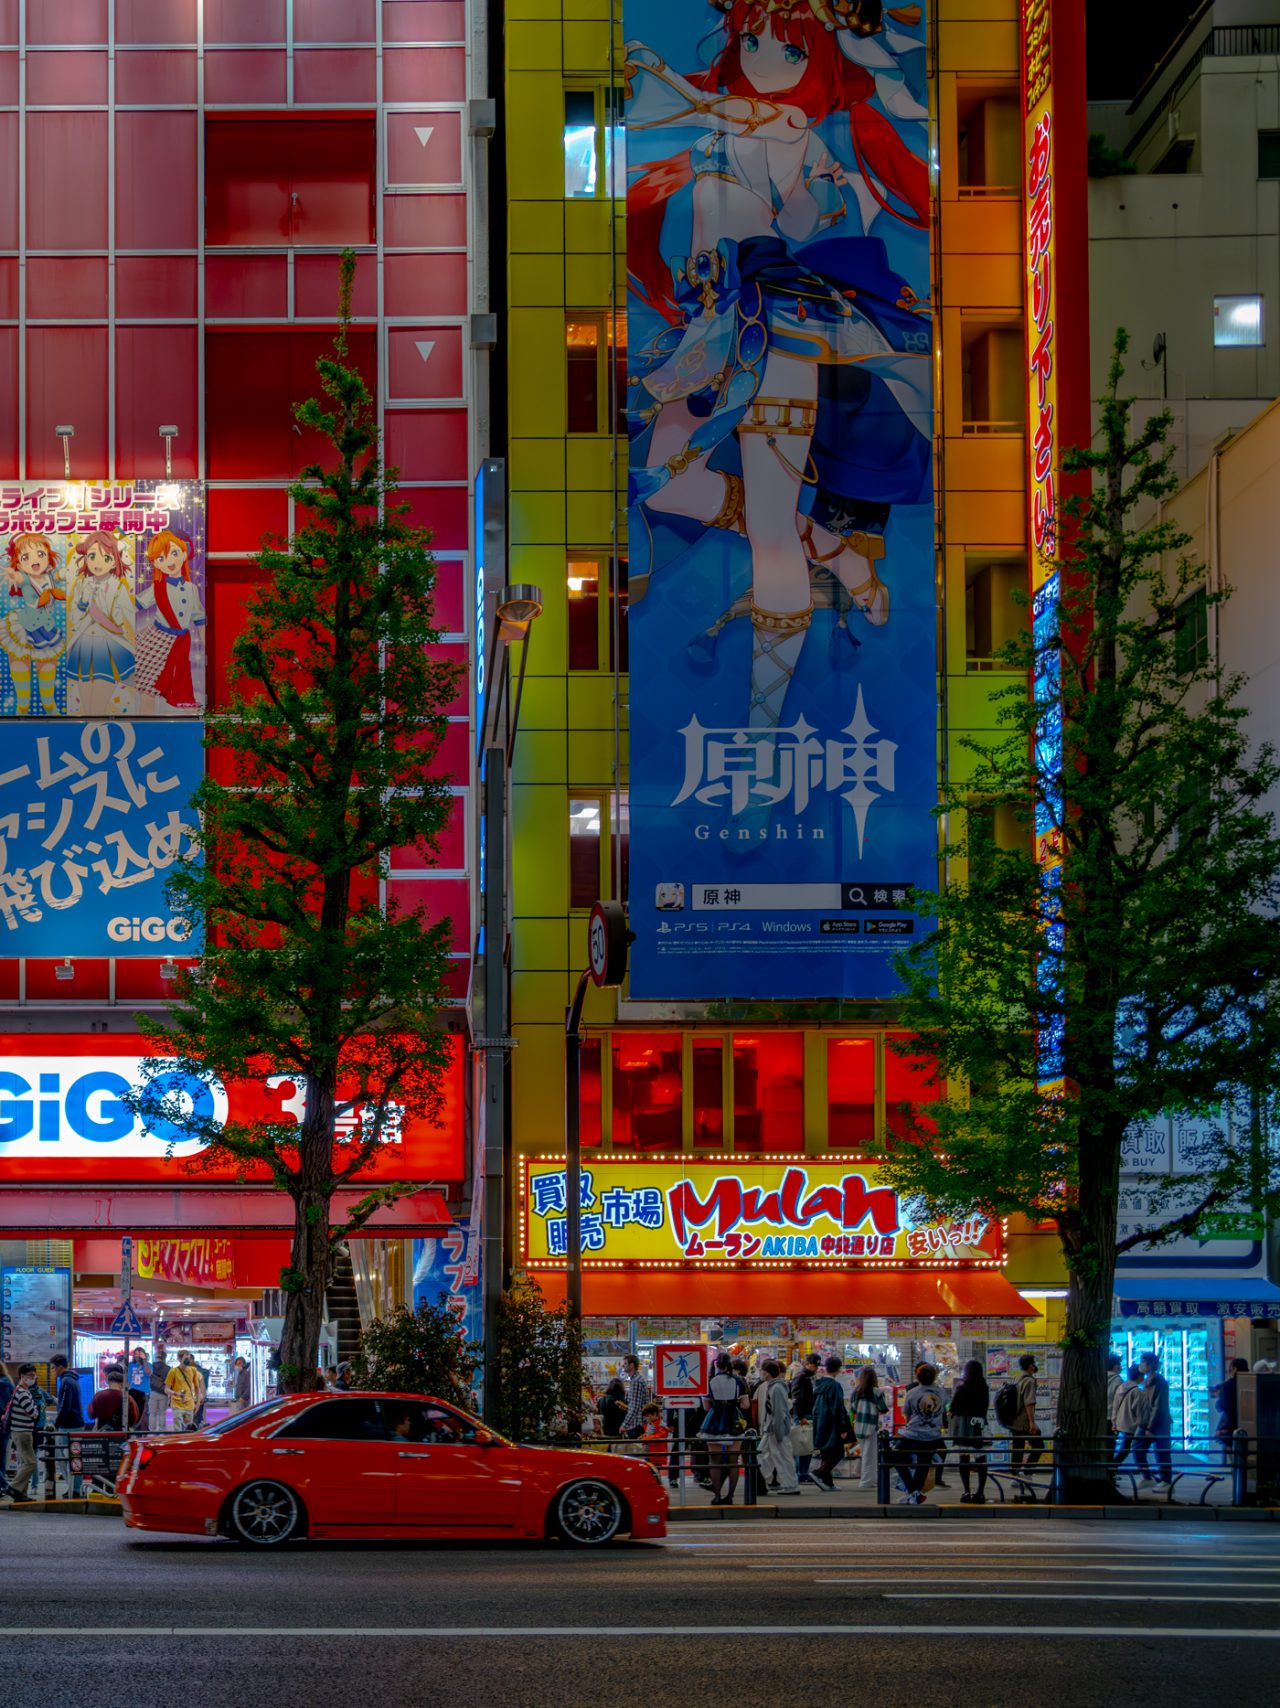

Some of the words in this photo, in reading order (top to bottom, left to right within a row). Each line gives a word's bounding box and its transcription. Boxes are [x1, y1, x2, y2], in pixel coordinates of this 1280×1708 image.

[670, 682, 899, 861] 原神
[694, 824, 825, 840] Genshin
[702, 888, 741, 905] 原神
[106, 916, 193, 942] GiGO
[674, 923, 708, 932] PS5
[718, 923, 752, 932] PS4
[762, 921, 812, 932] Windows
[1132, 1158, 1156, 1167] BUY
[601, 1186, 664, 1229] 市場
[666, 1166, 903, 1248] Mulan
[685, 1231, 761, 1259] ムーラン
[762, 1236, 819, 1256] AKIBA
[820, 1235, 896, 1257] 中央通り店
[1136, 1301, 1200, 1315] 高額買取
